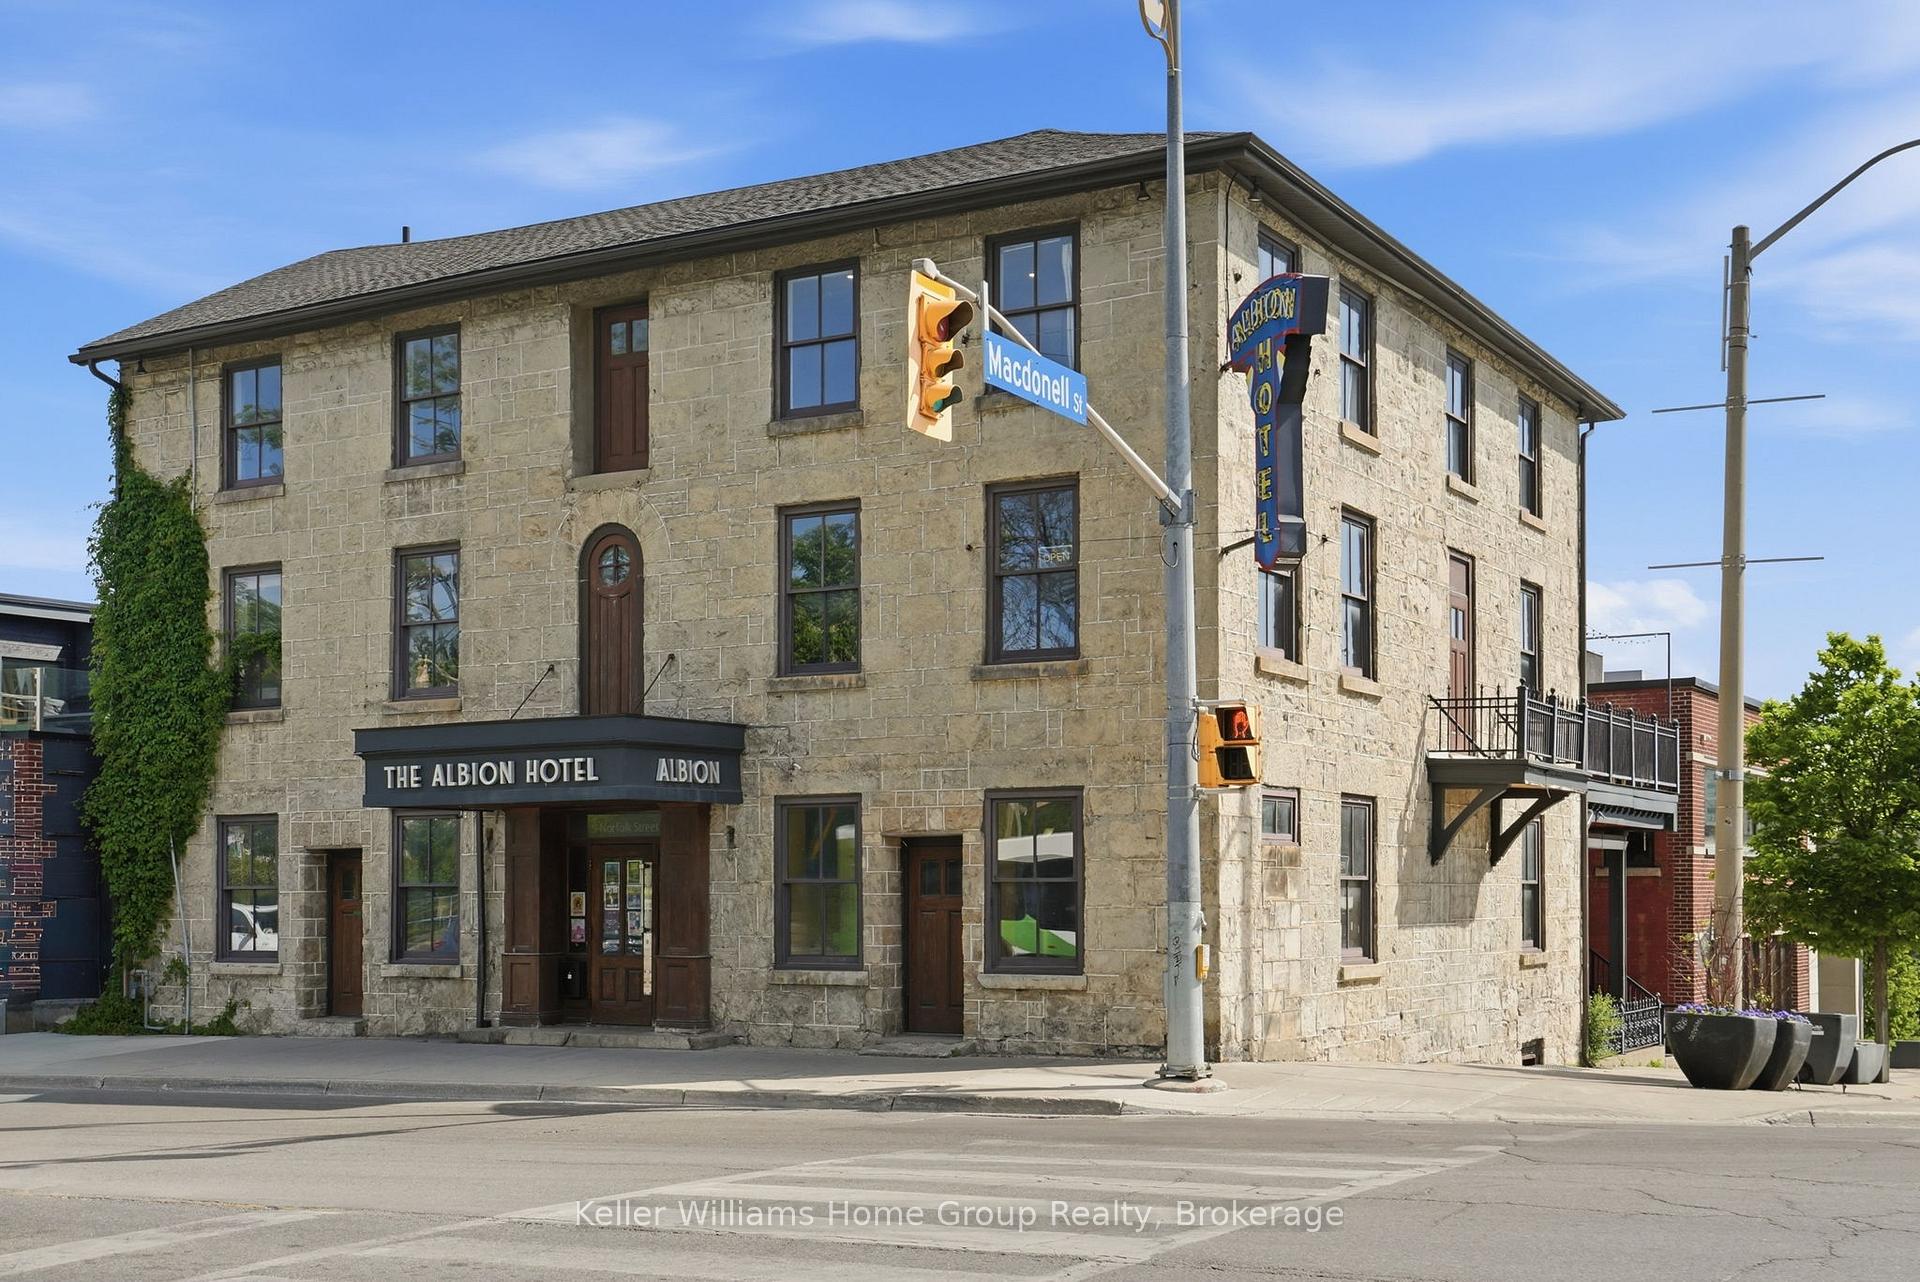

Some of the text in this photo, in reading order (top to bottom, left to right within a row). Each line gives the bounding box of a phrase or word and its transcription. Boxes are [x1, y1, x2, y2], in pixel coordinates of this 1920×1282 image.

[1232, 288, 1296, 352] ALBION
[988, 341, 1083, 415] Macdonell St
[1255, 338, 1272, 543] HOTEL
[1044, 551, 1071, 562] OPEN
[384, 757, 599, 789] THE ALBION HOTEL
[656, 758, 720, 784] ALBION
